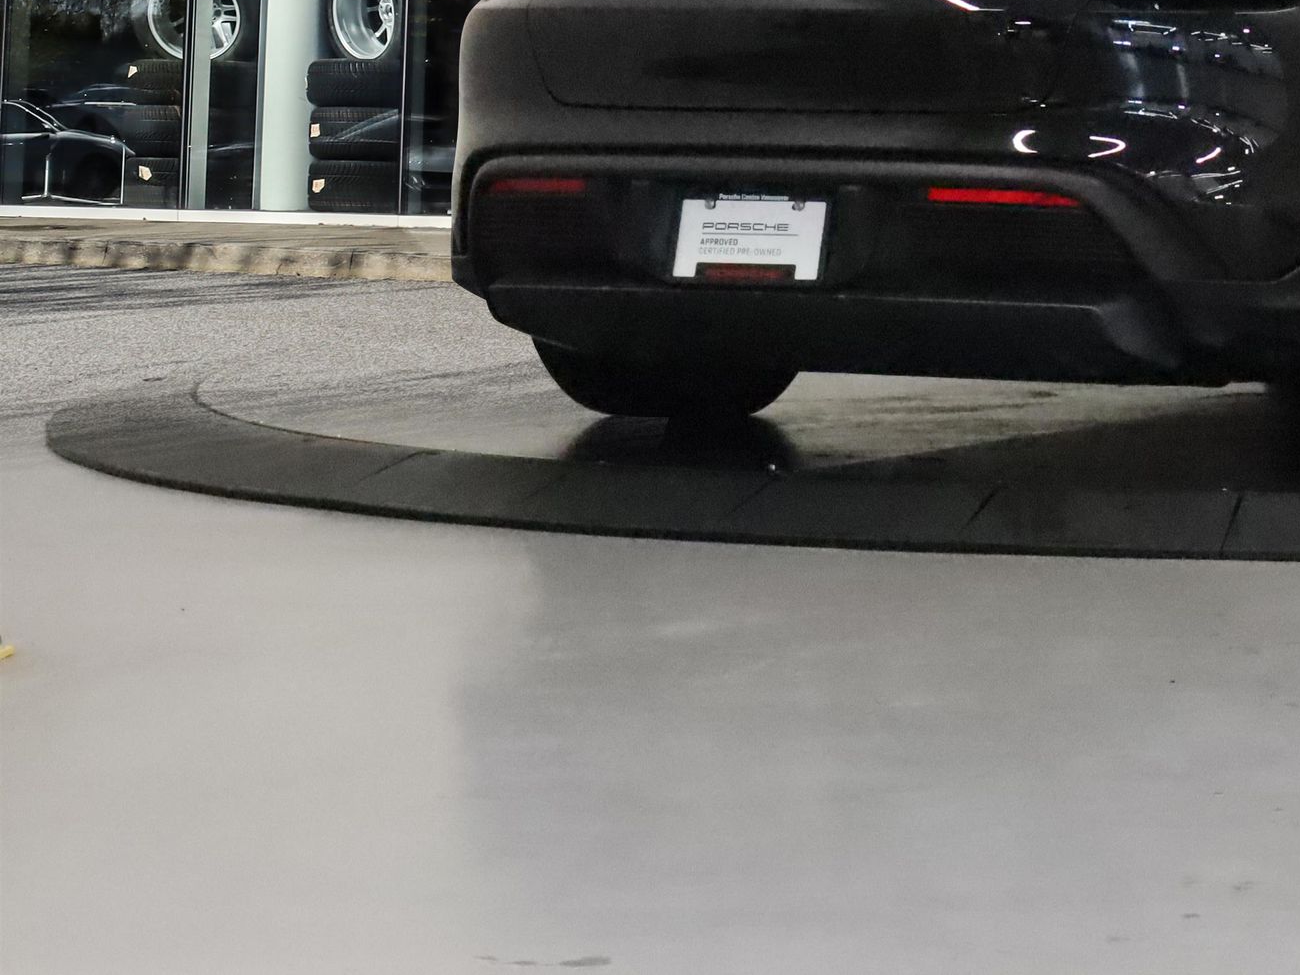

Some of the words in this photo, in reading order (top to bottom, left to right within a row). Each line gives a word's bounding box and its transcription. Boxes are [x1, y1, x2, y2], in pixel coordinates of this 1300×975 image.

[702, 222, 789, 232] PORSCHE
[700, 238, 738, 246] APPROVED
[699, 246, 735, 256] CERTIFIED
